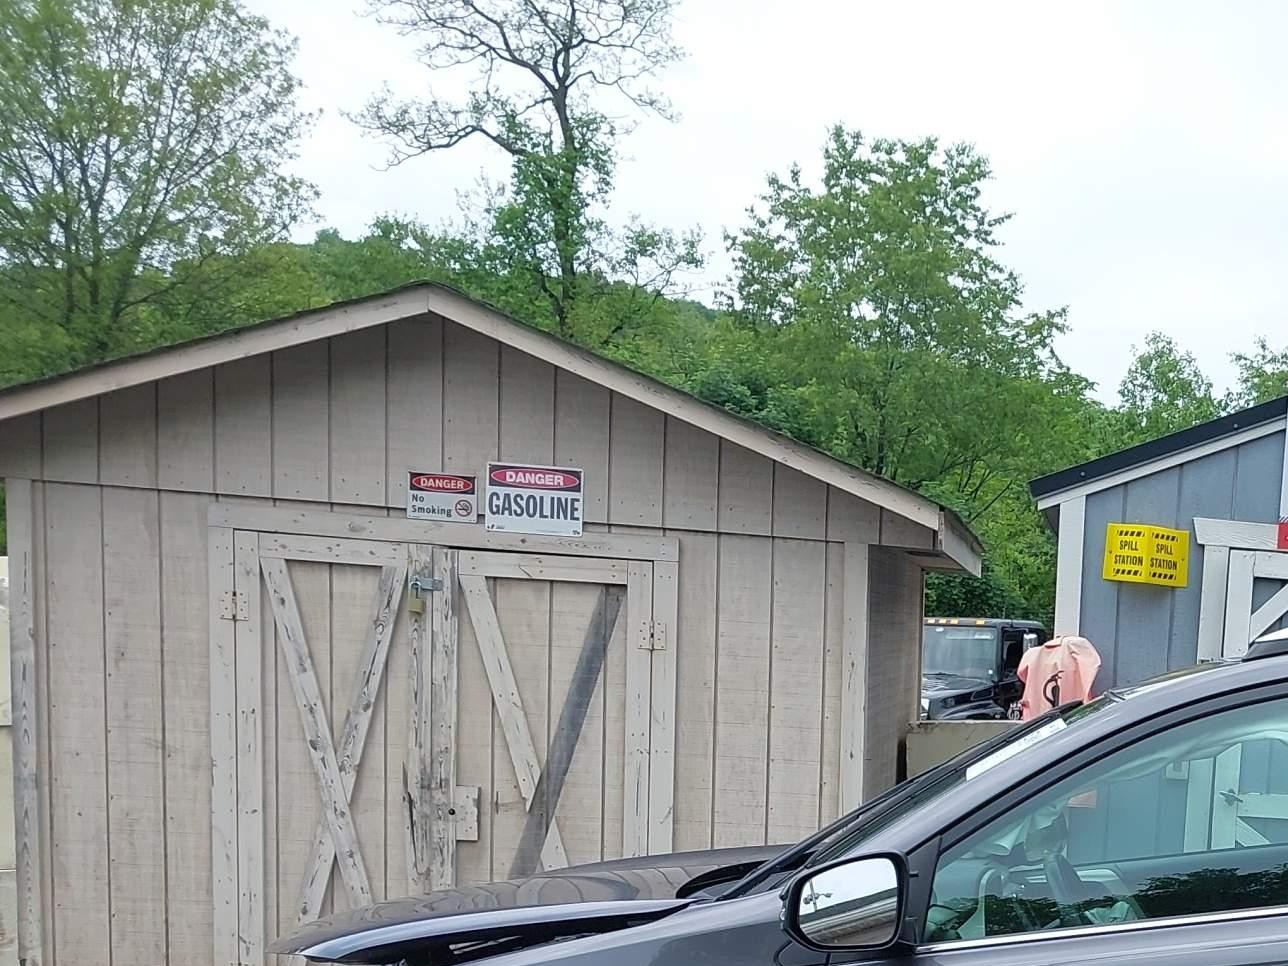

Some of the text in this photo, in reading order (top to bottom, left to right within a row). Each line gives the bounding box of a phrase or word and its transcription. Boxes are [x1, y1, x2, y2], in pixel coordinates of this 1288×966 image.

[420, 477, 464, 490] DANGER
[506, 471, 564, 487] DANGER
[411, 493, 425, 503] No
[411, 504, 452, 518] Smoking
[488, 491, 580, 522] GASOLINE
[1119, 539, 1139, 551] SPILL
[1155, 543, 1174, 555] SPILL
[1113, 554, 1144, 566] STATION
[1149, 557, 1178, 571] STATION
